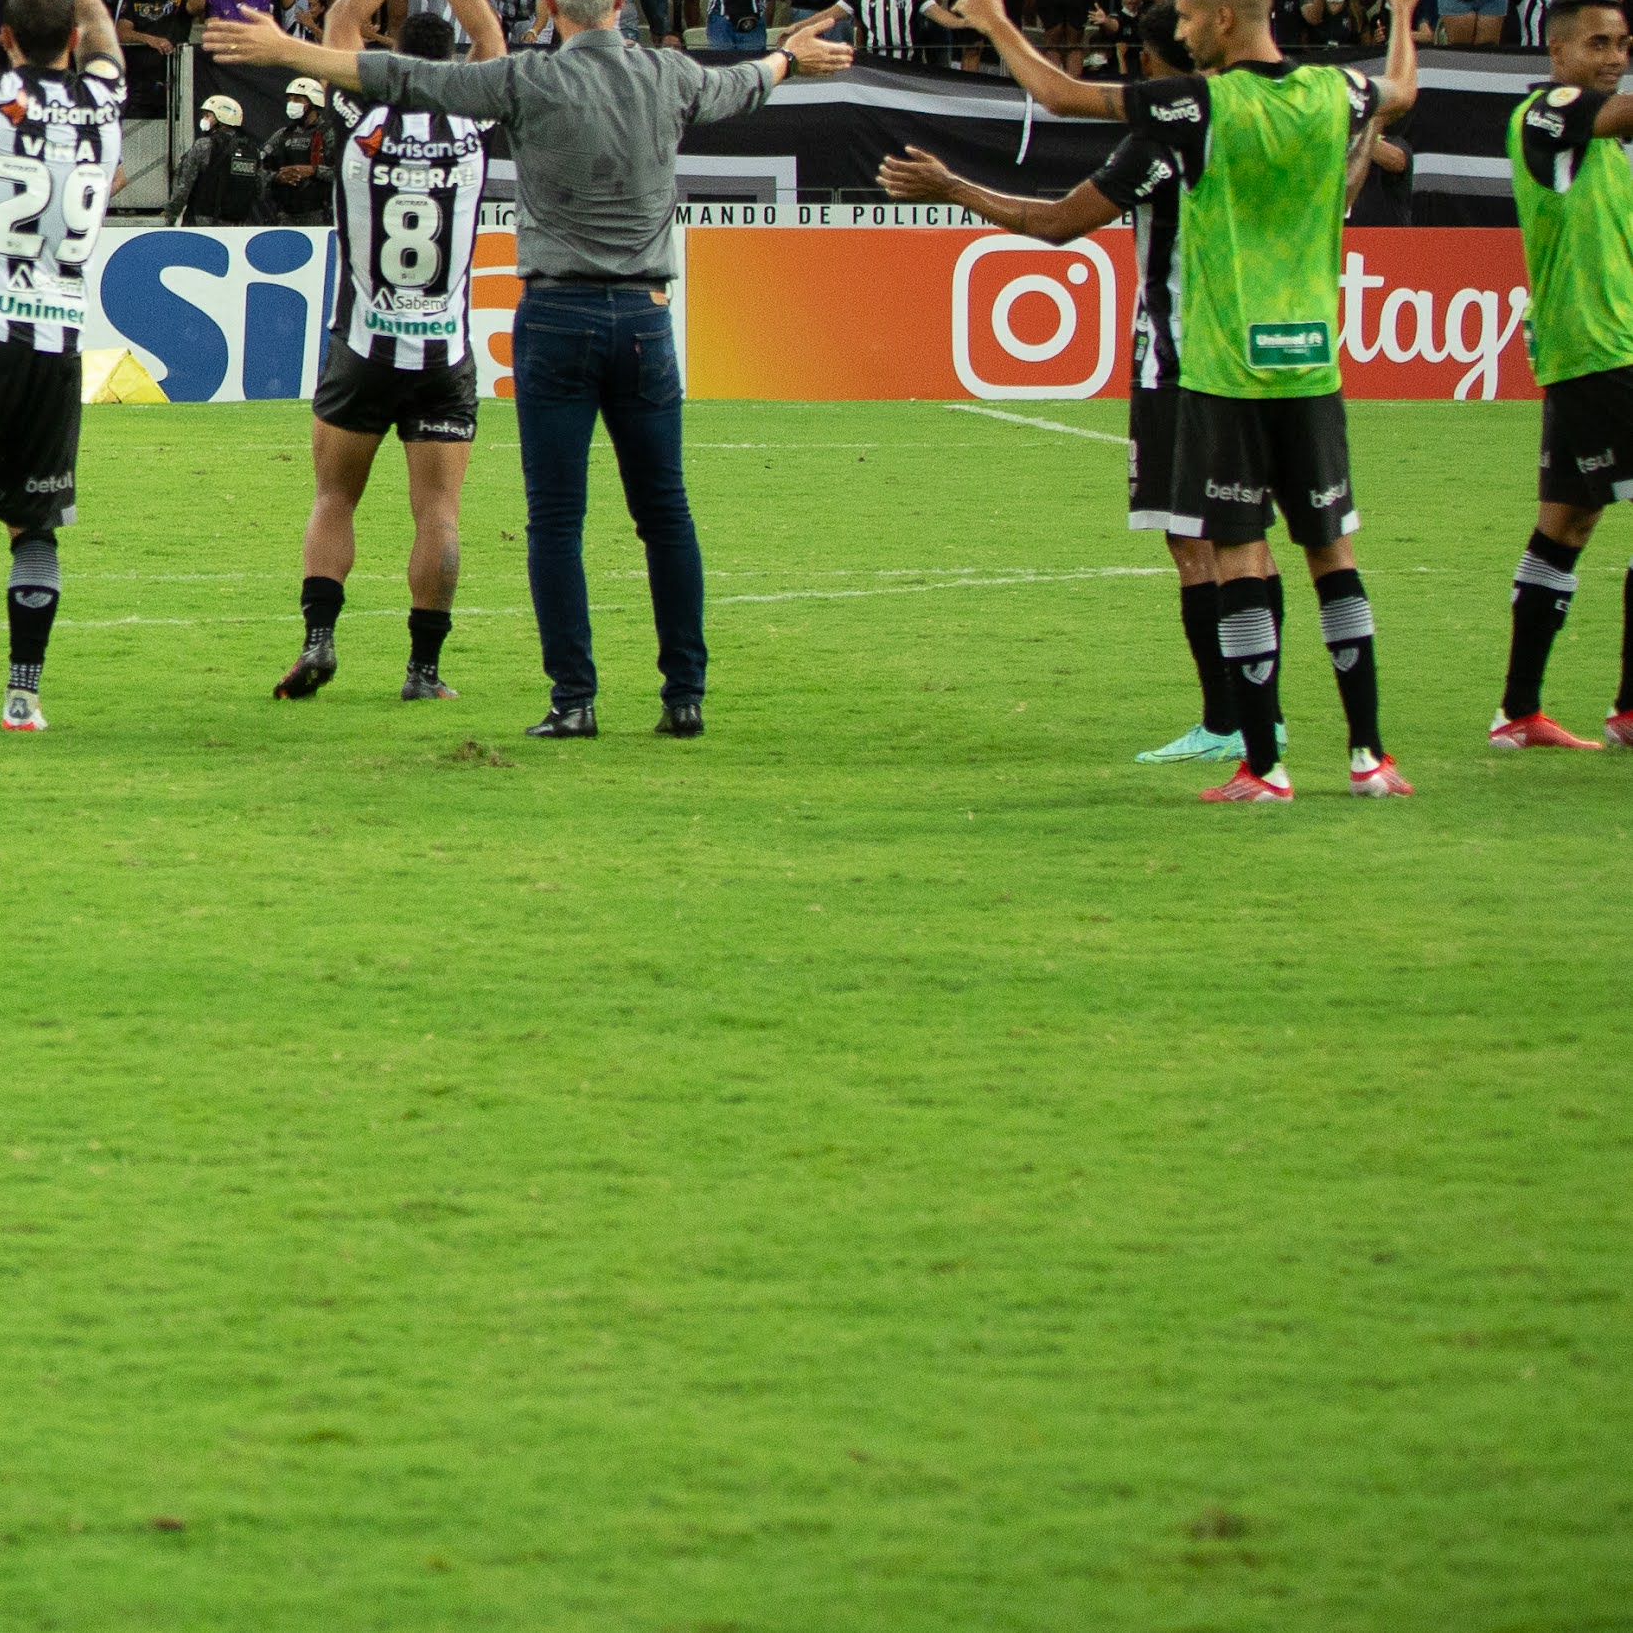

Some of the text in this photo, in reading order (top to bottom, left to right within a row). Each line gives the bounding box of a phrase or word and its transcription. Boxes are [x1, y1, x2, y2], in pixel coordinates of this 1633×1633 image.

[26, 99, 120, 128] brisanet
[380, 134, 480, 160] brisanet
[373, 163, 479, 190] SOBRAL
[676, 206, 777, 225] MANDO
[799, 206, 831, 225] DE
[853, 206, 996, 226] POLICIA
[379, 193, 443, 290] 8
[364, 310, 457, 336] Unimed
[1575, 447, 1616, 474] tsul
[24, 470, 75, 494] betul
